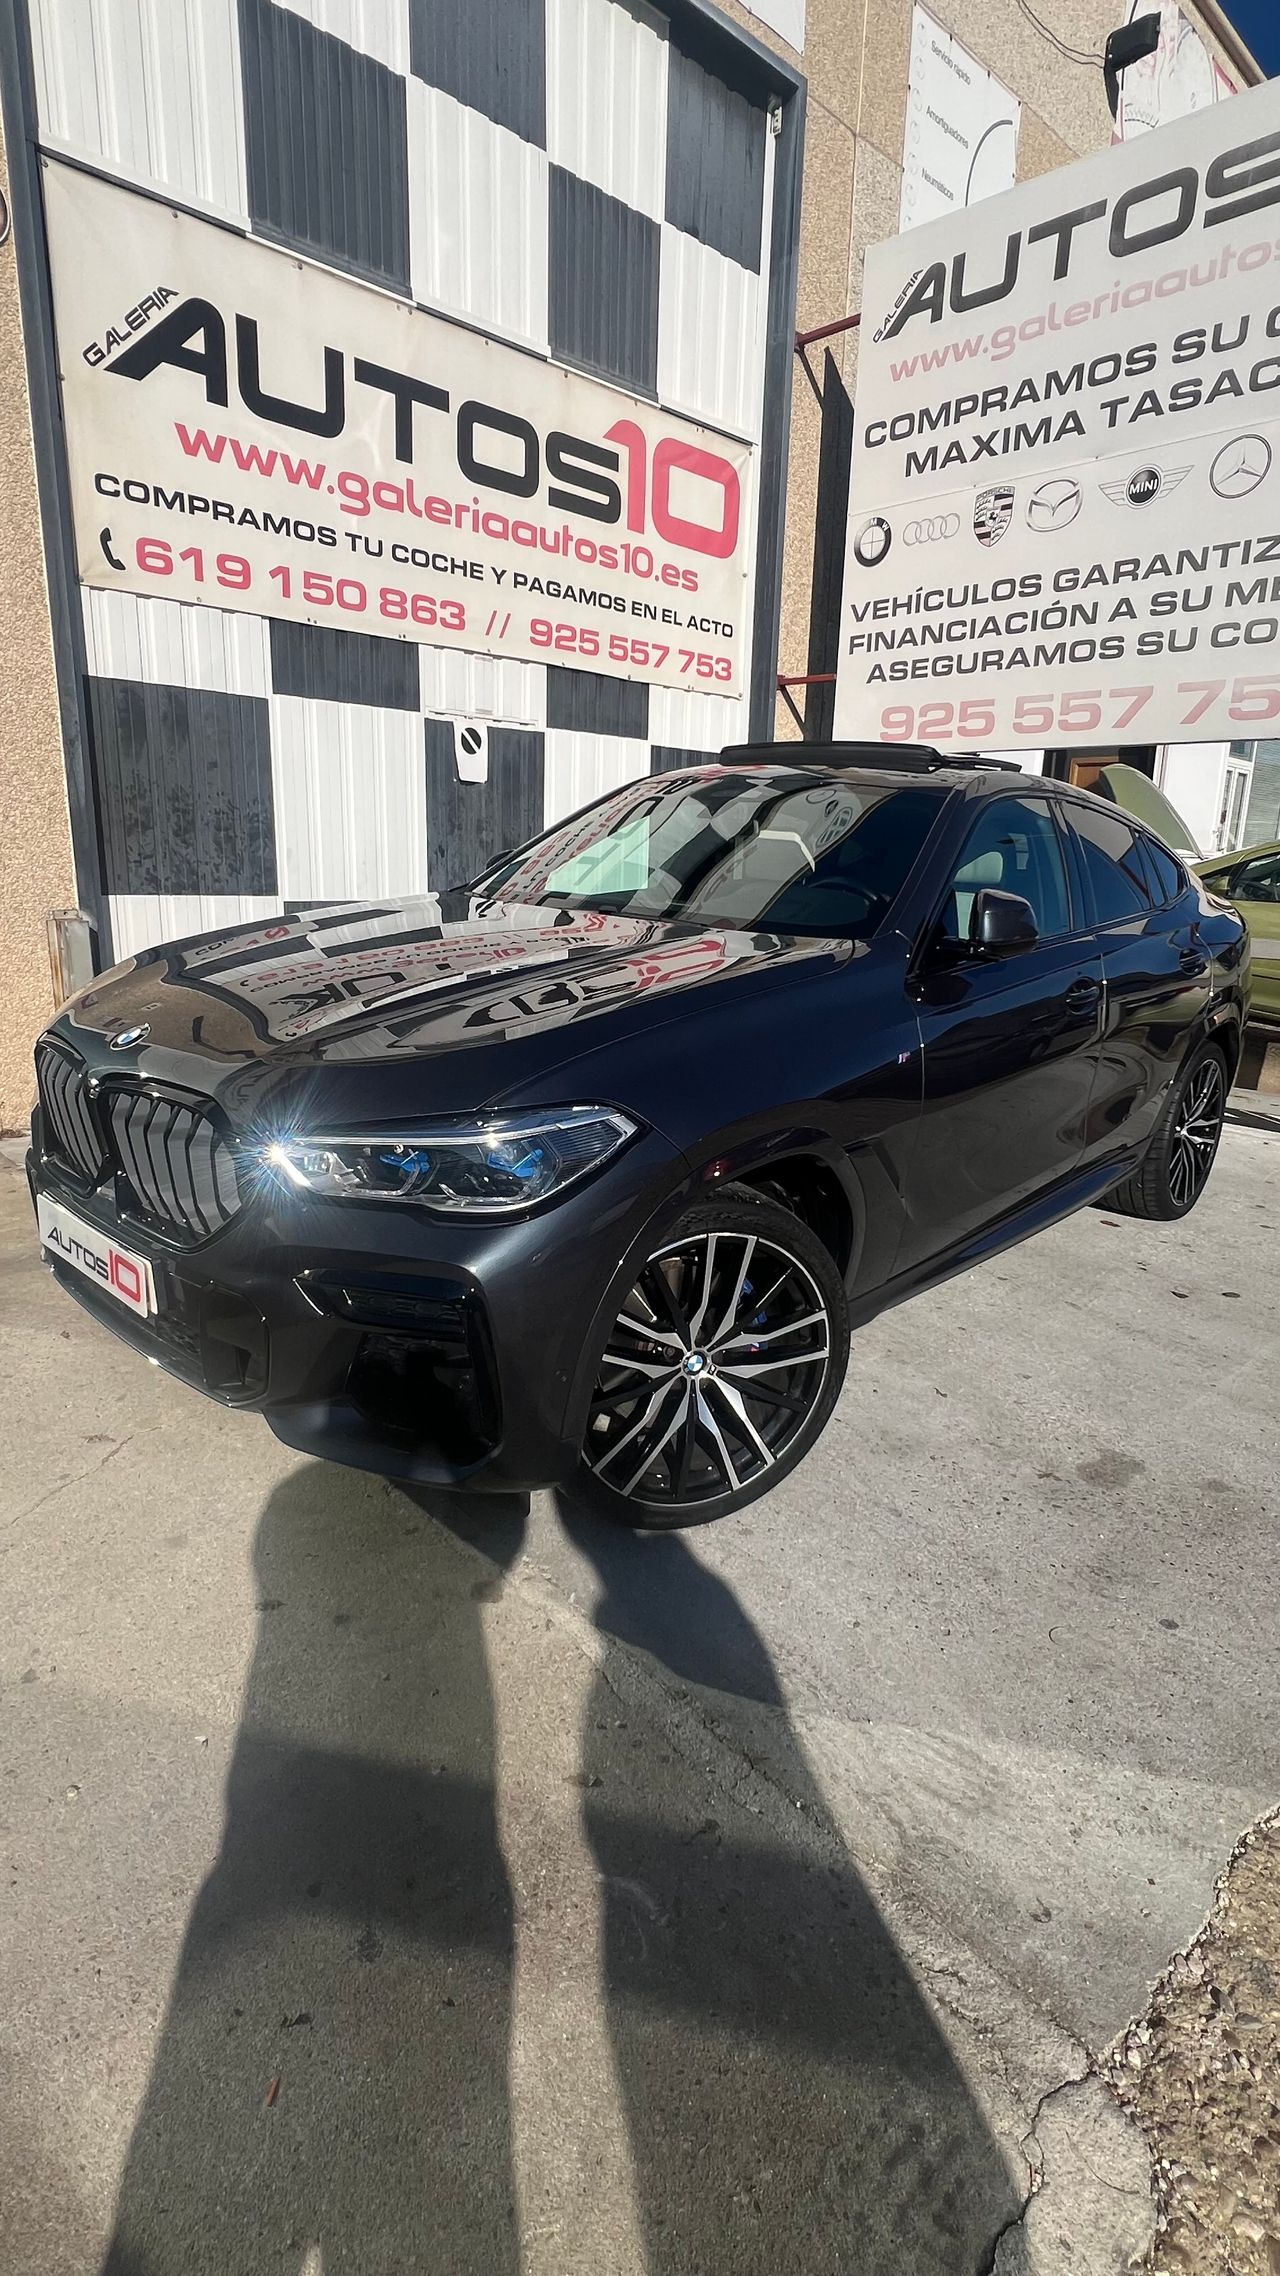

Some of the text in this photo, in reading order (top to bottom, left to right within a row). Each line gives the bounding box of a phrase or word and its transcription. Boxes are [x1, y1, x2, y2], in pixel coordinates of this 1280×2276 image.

[931, 39, 953, 70] Servicio
[926, 105, 969, 150] Amortiguadores
[82, 286, 180, 367] GALERIA
[873, 269, 924, 344] GALERIA
[865, 342, 1158, 449] COMPRAMOS
[1171, 314, 1250, 364] SU
[905, 356, 1280, 478] MAXIMA TASAC
[103, 296, 741, 560] AUTOS10
[174, 422, 699, 593] www.galeriaautos10.es
[1129, 478, 1159, 495] MINI
[94, 472, 734, 639] COMPRAMOS TU COCHE Y PAGAMOS EN EL ACTO
[135, 536, 252, 590] 619
[269, 565, 367, 613] 150
[379, 586, 466, 632] 863
[529, 618, 600, 657] 925
[608, 635, 670, 669] 557
[678, 649, 732, 682] 753
[849, 600, 1099, 655] FINANCIACIÓN
[1108, 597, 1138, 623] A
[1149, 585, 1213, 617] SU
[851, 573, 1042, 623] VEHÍCULOS
[866, 617, 1279, 684] ASEGURAMOS SU CO
[879, 673, 1280, 742] 925 557 75
[48, 1226, 141, 1303] AUTOS10
